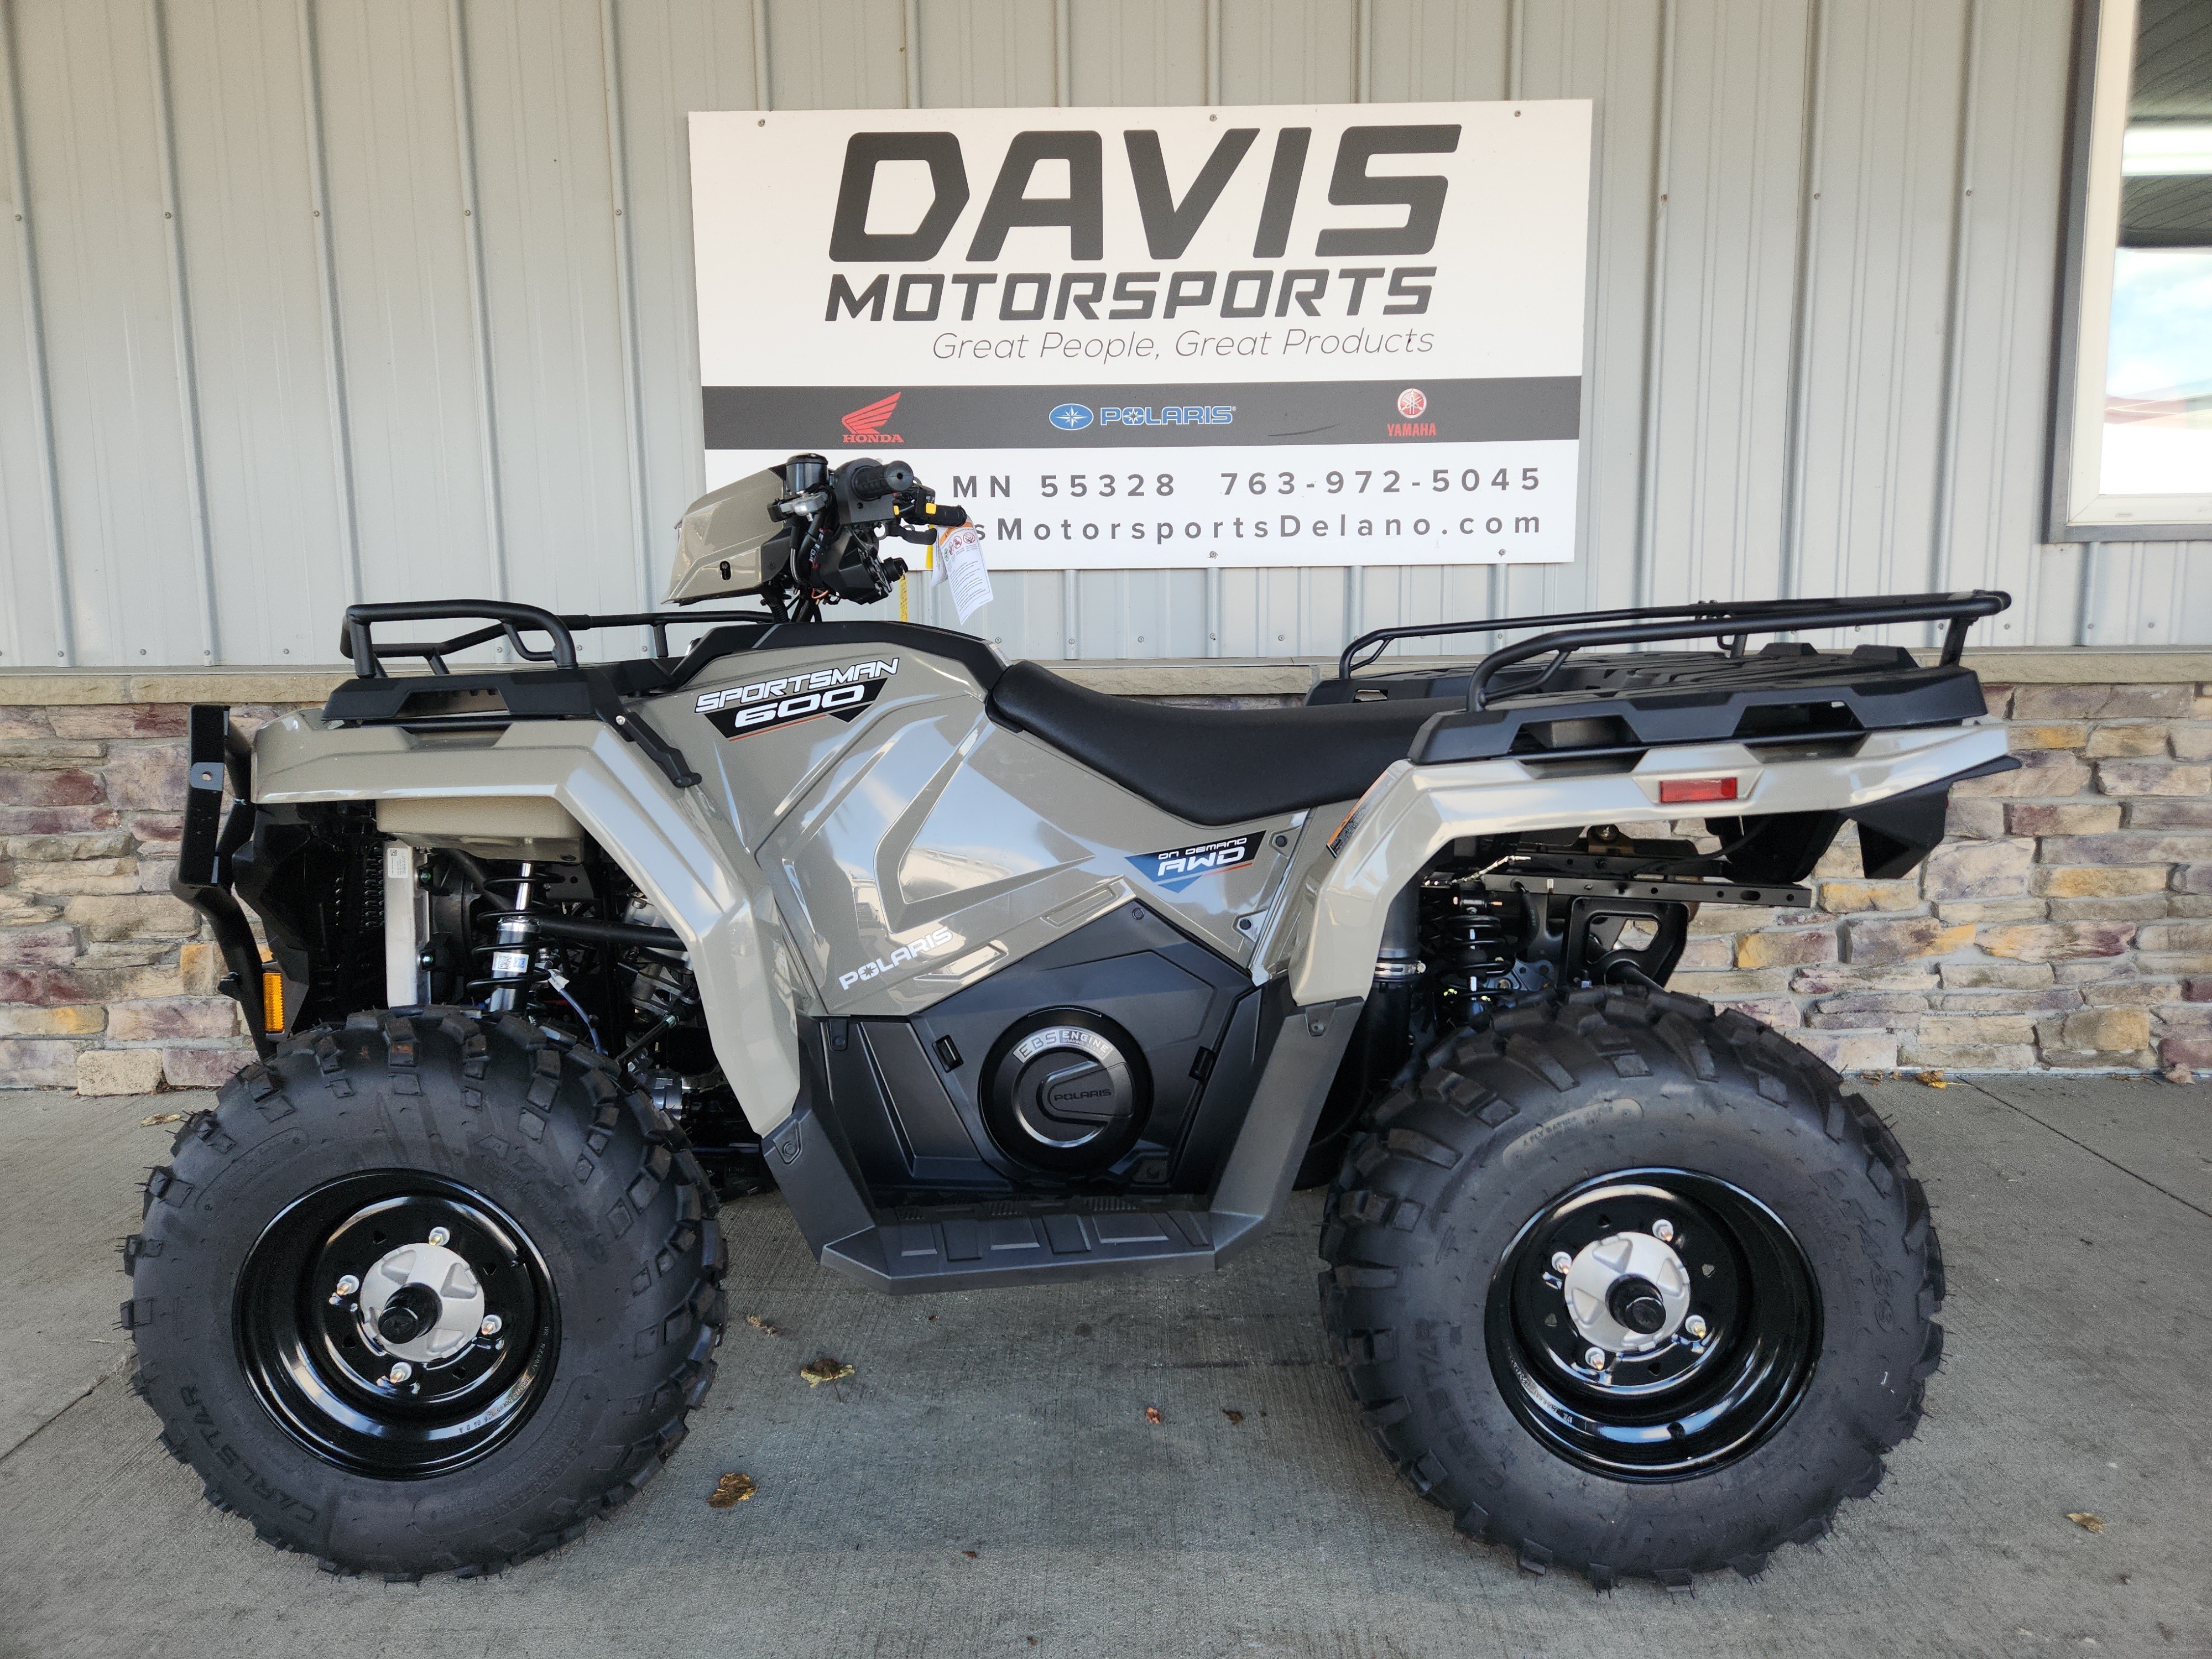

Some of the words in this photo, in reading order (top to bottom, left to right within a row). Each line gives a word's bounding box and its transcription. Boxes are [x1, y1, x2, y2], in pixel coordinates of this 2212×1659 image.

[829, 124, 1462, 262] DAVIS
[825, 267, 1437, 321] MOTORSPORTS
[933, 332, 1029, 359] Great
[1040, 331, 1160, 364] People,
[1176, 330, 1272, 357] Great
[1283, 327, 1435, 356] Products
[1100, 405, 1233, 426] POLARIS
[1387, 422, 1437, 437] YAMAHA
[843, 434, 905, 443] HONDA
[953, 476, 1010, 498] MN
[1041, 473, 1175, 498] 55328
[1221, 467, 1540, 495] 763-972-5045
[877, 514, 1540, 545] sMotorsportsDelano.com
[696, 658, 899, 713] SPORTSMAN
[735, 684, 864, 728] 600
[1157, 846, 1245, 877] AWD
[1158, 851, 1179, 860] ON
[1185, 837, 1248, 855] DEMAND
[838, 925, 953, 990] POLARIS
[1018, 1031, 1057, 1058] EBS
[1062, 1031, 1109, 1053] ENGINE
[1053, 1089, 1112, 1102] POLARIS
